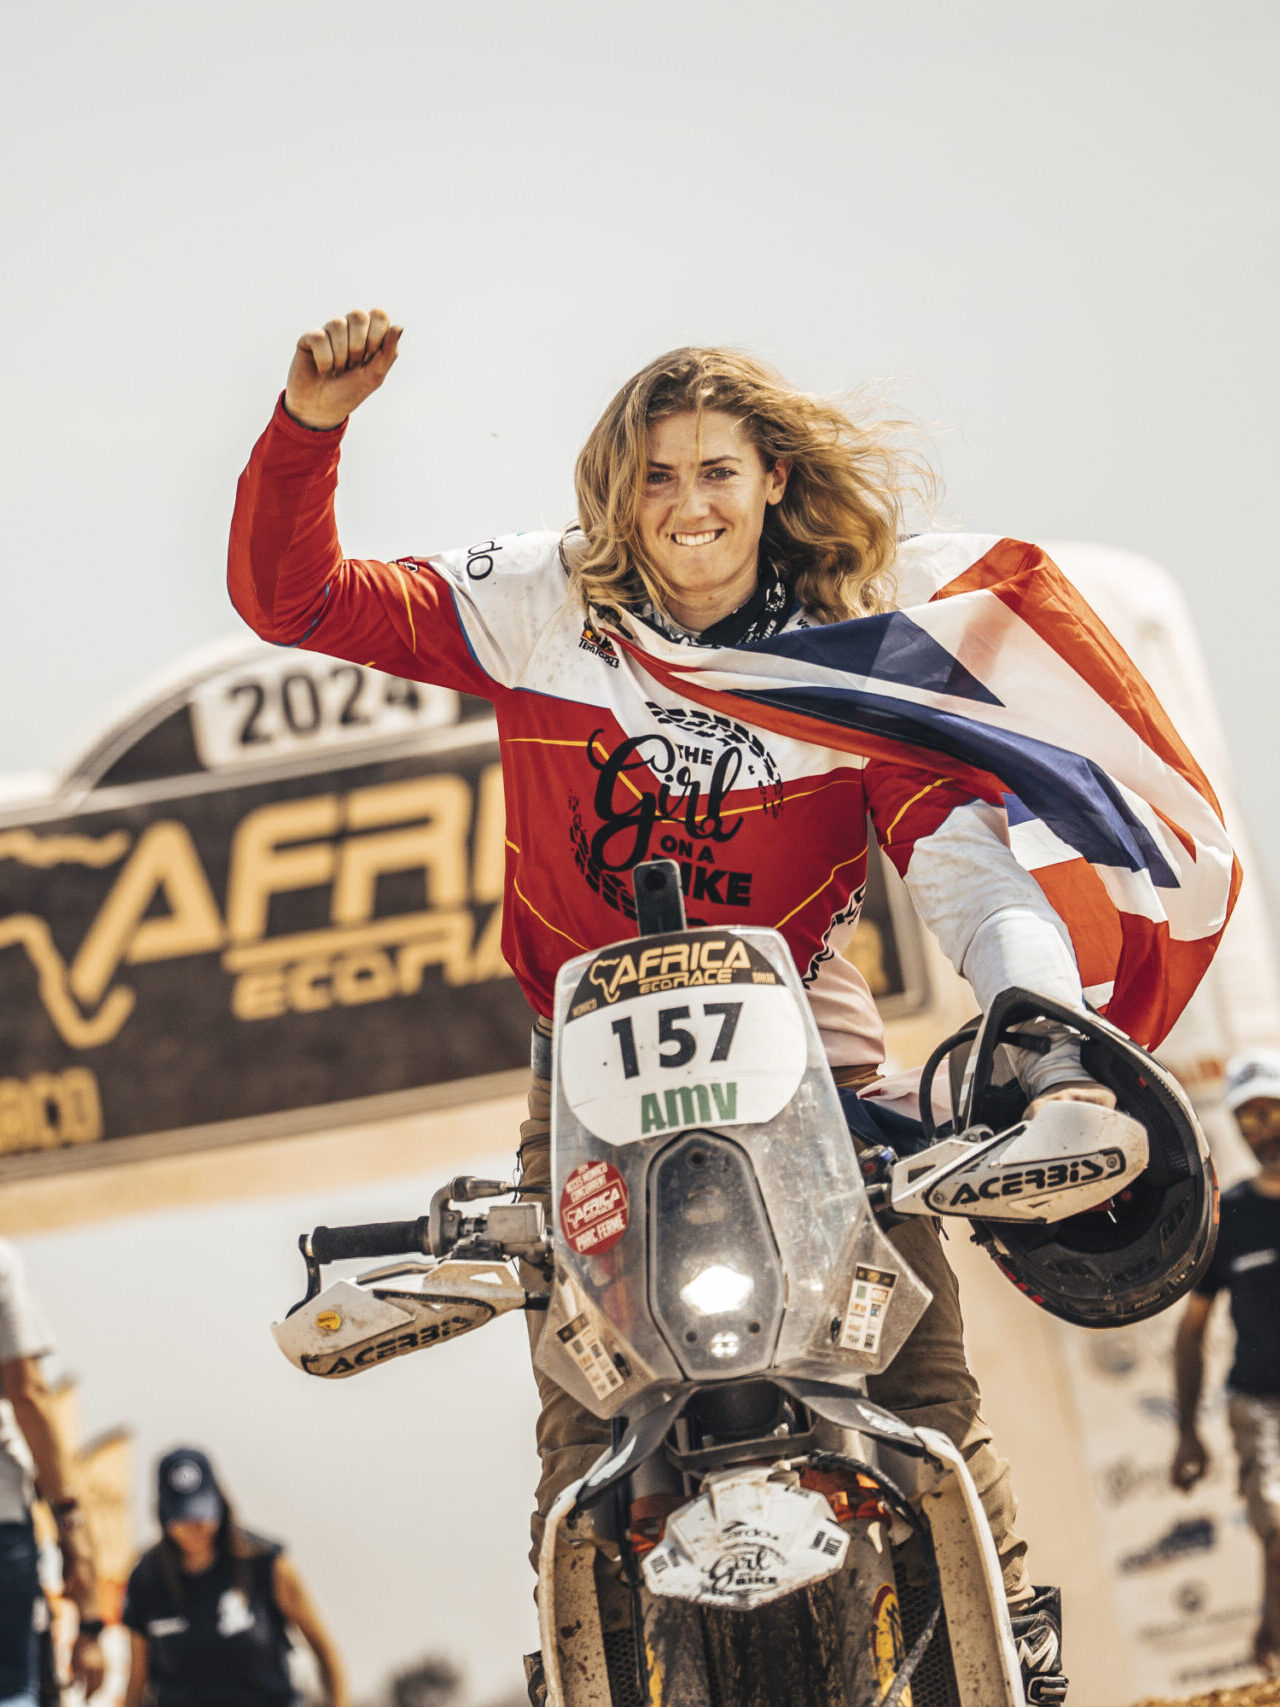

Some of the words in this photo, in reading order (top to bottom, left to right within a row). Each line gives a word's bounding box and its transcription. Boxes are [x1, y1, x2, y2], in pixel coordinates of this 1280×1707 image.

[675, 744, 714, 766] THE
[586, 728, 744, 872] Girl
[660, 835, 693, 858] ON
[697, 846, 715, 864] A
[72, 765, 505, 1004] AFRI
[651, 853, 753, 908] IKE
[609, 940, 751, 994] AFRICA
[611, 1002, 744, 1080] 157
[949, 1159, 1105, 1207] ACERBIS
